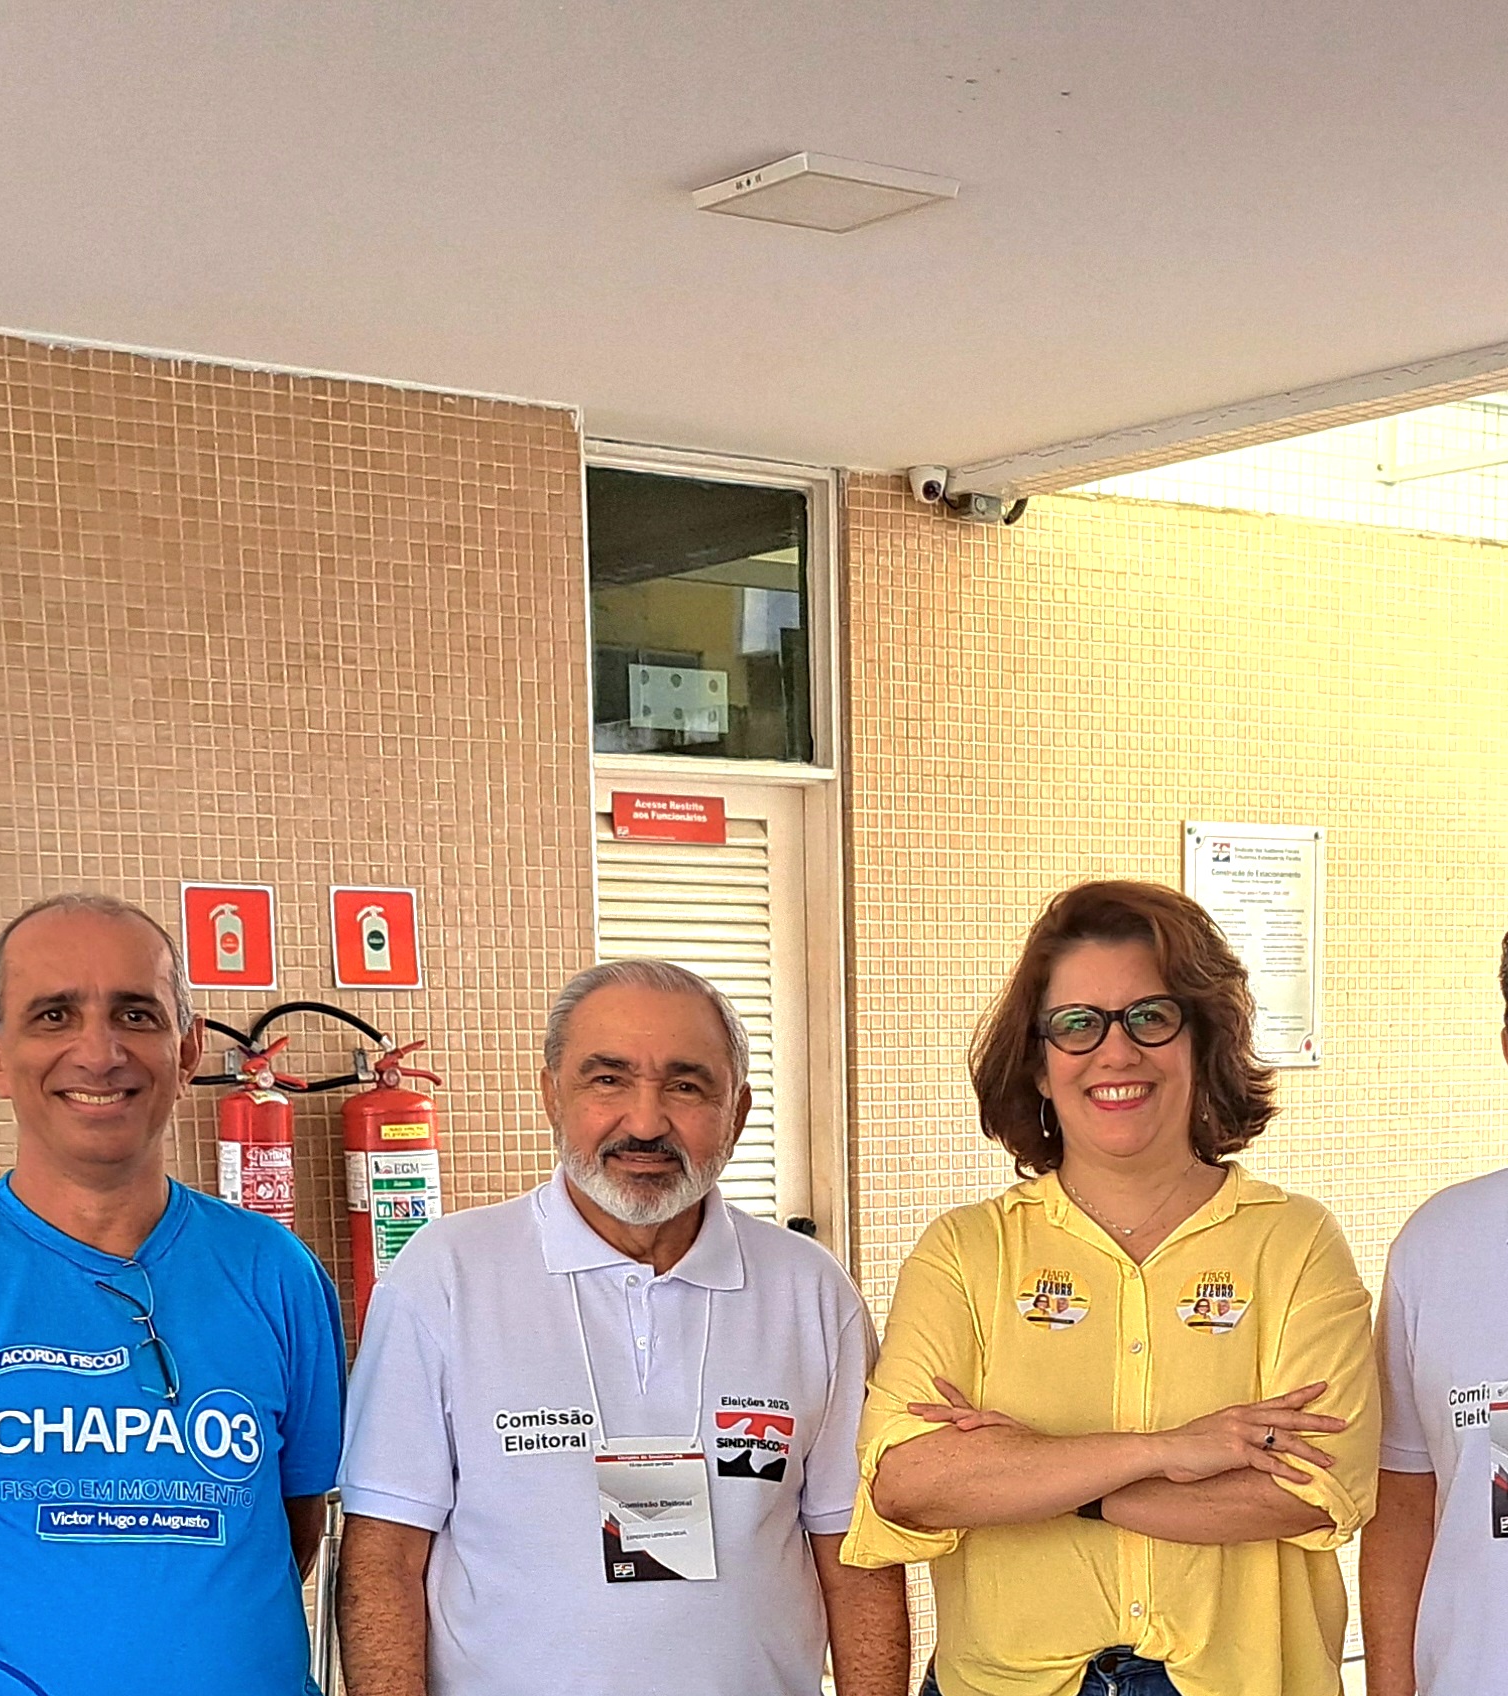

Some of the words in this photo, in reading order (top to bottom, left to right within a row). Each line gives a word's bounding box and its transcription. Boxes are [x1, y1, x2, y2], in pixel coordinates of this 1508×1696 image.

[394, 1162, 420, 1175] EGM
[0, 1348, 68, 1366] ACORDA
[70, 1352, 122, 1369] FISCO!
[721, 1396, 765, 1409] Eleições
[767, 1398, 790, 1411] 2025
[1449, 1384, 1490, 1406] Comi
[496, 1409, 594, 1429] Comissão
[194, 1409, 261, 1463] 03
[504, 1432, 587, 1452] Eleitoral
[0, 1478, 73, 1501] FISCO
[78, 1480, 114, 1501] EM
[118, 1479, 255, 1508] MOVIMENTO
[50, 1510, 95, 1526] Victor
[97, 1512, 137, 1529] Hugo
[139, 1516, 149, 1526] e
[151, 1512, 210, 1529] Augusto
